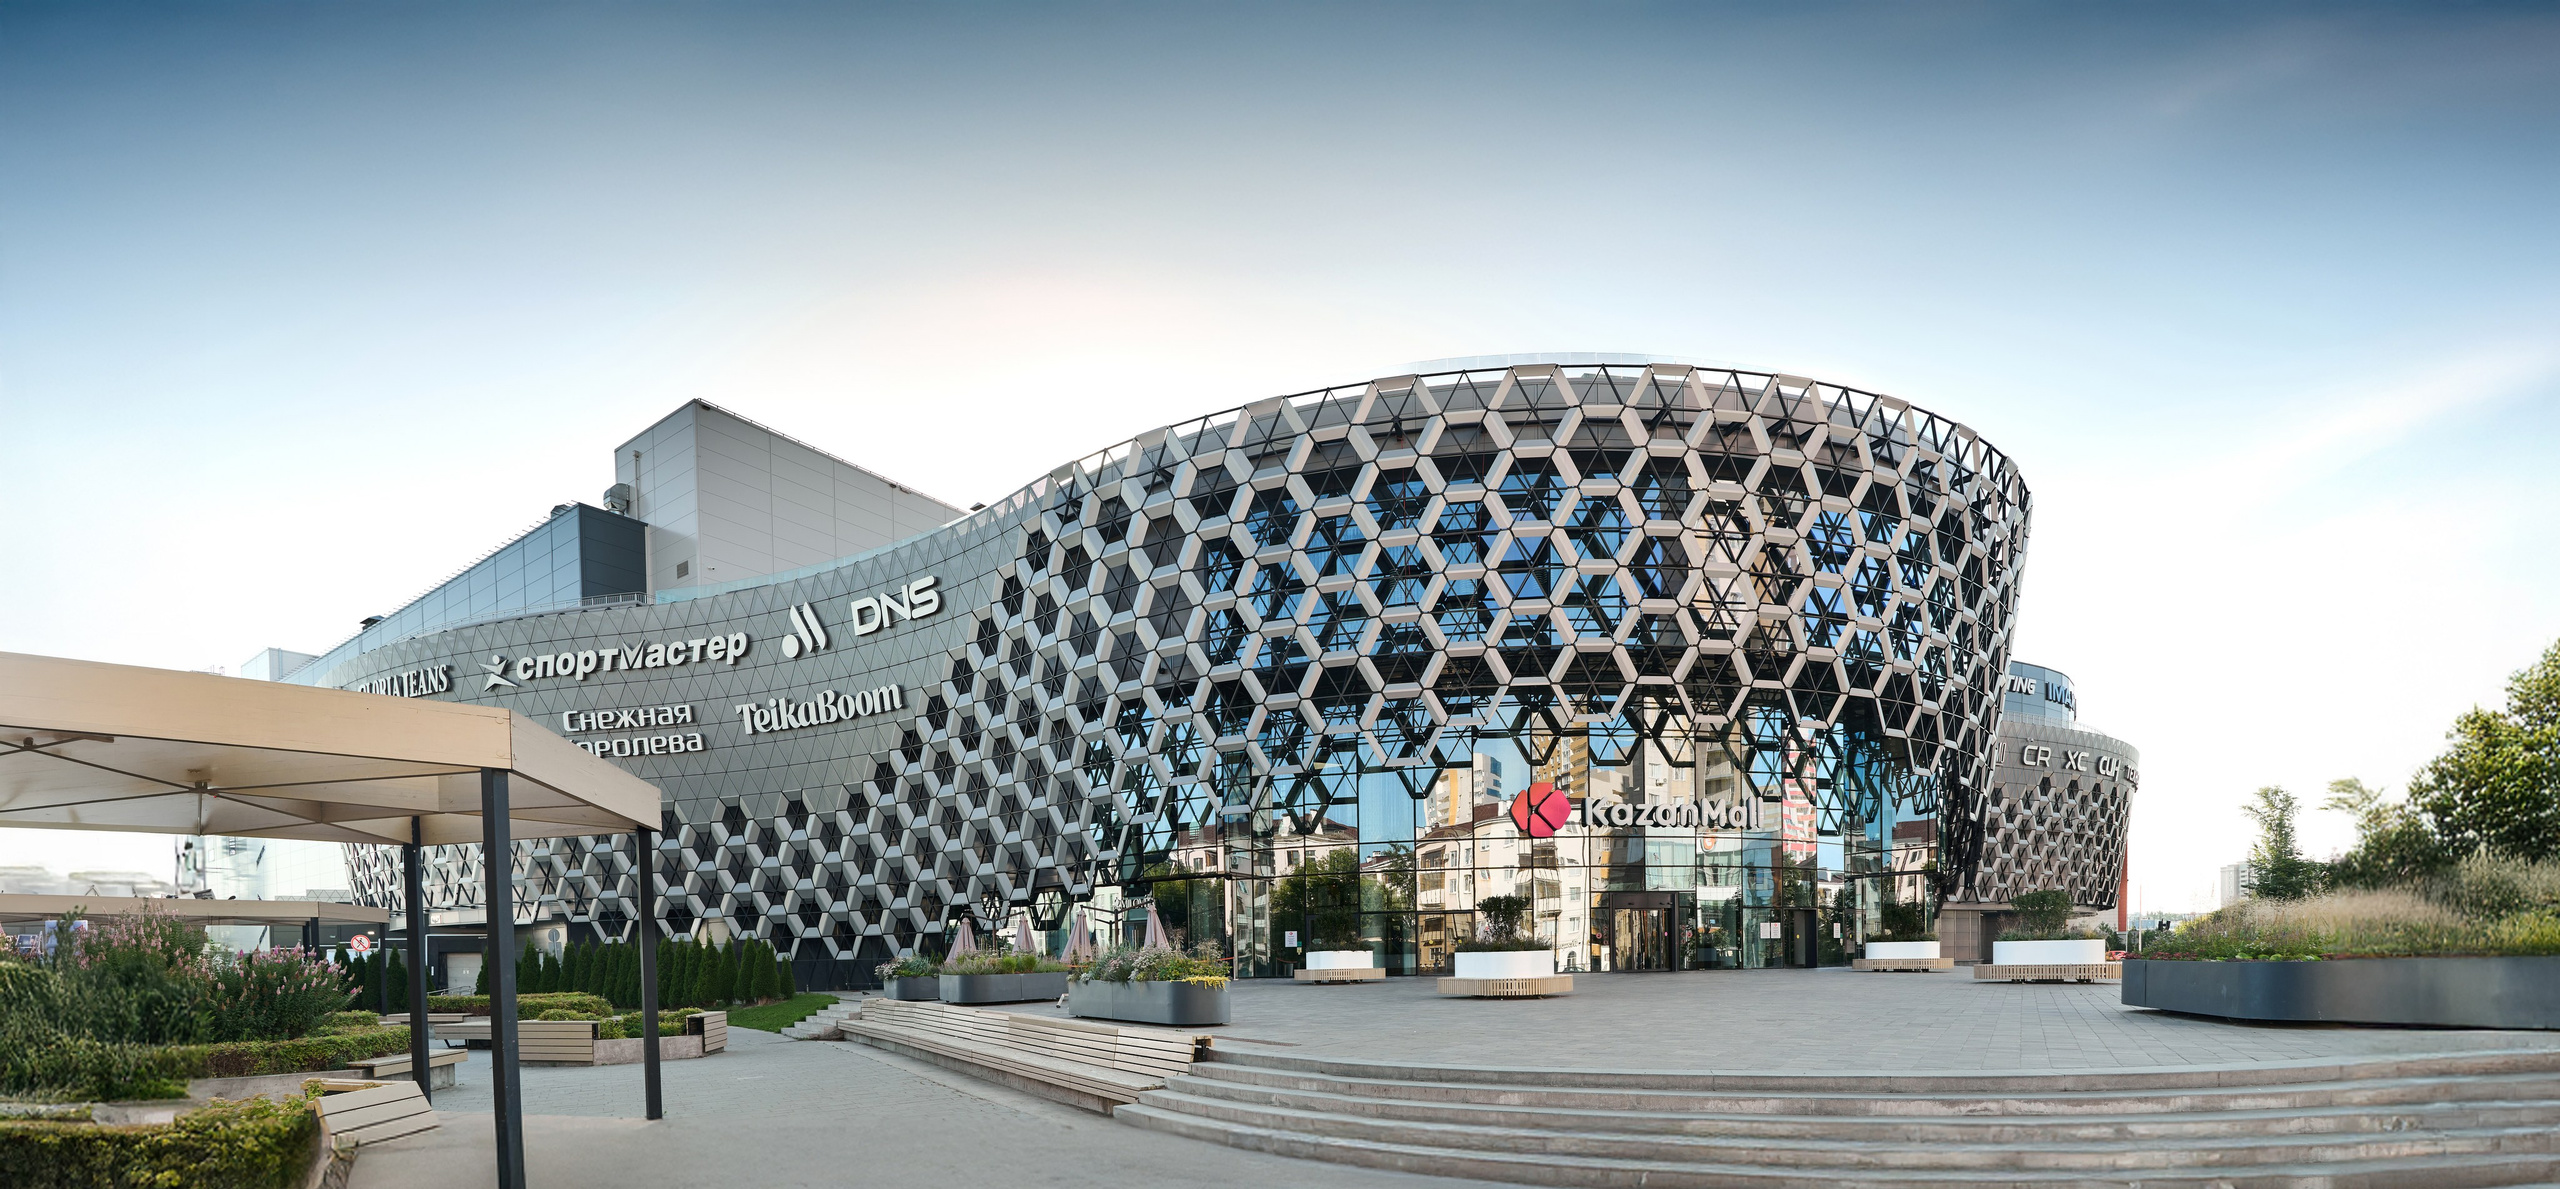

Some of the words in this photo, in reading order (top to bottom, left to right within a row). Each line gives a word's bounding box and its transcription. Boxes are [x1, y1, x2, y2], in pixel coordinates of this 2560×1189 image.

[851, 575, 941, 636] DNS
[562, 704, 693, 732] Снежная
[735, 683, 903, 735] TeikaBoom
[570, 732, 705, 758] оролева
[2023, 744, 2052, 768] CR
[1585, 796, 1765, 830] KazanMall
